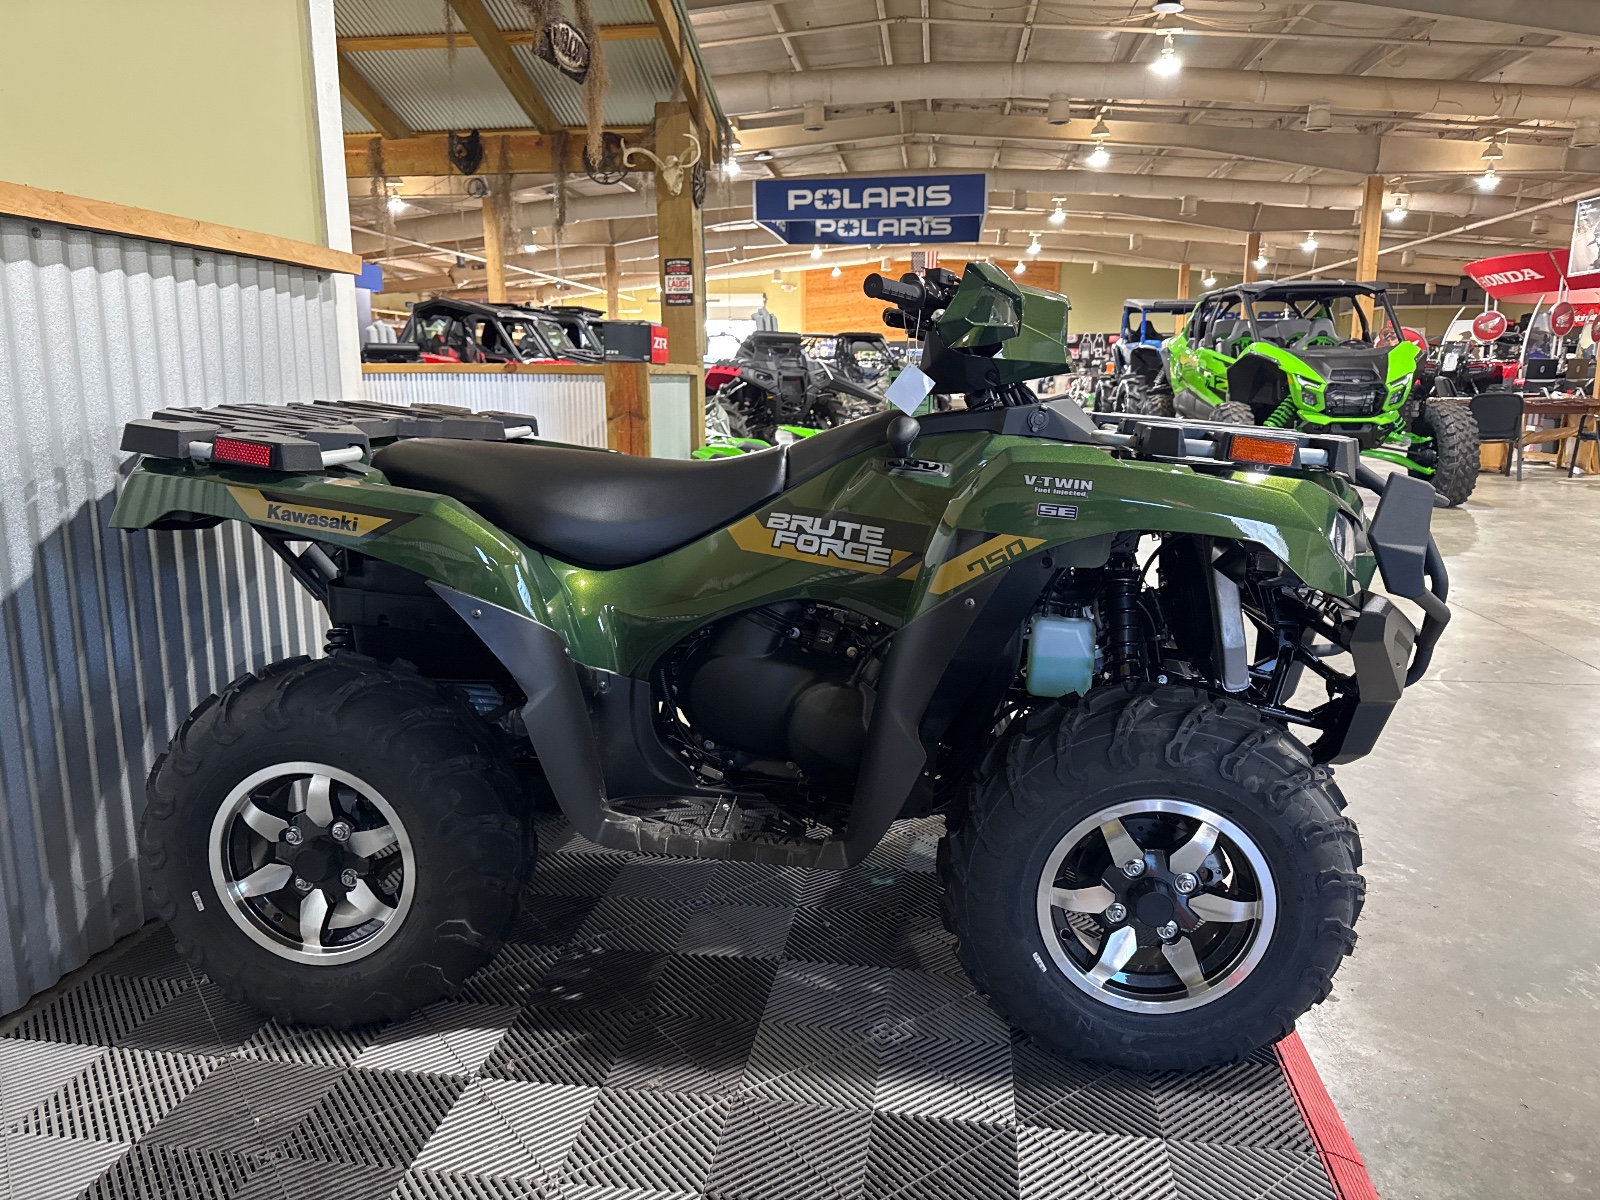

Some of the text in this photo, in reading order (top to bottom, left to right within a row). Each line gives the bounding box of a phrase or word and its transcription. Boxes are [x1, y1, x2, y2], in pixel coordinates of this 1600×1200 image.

[787, 184, 952, 211] POLARIS
[814, 217, 952, 237] POLARIS
[668, 280, 690, 288] LAUGH
[1477, 268, 1545, 288] HONDA
[1023, 474, 1094, 491] V-TWIN
[1034, 486, 1087, 497] Fuel Injected
[266, 503, 359, 532] Kawasaki
[1039, 505, 1076, 518] SE
[766, 511, 885, 546] BRUTE
[772, 529, 892, 567] FORCE
[966, 538, 1028, 574] 750
